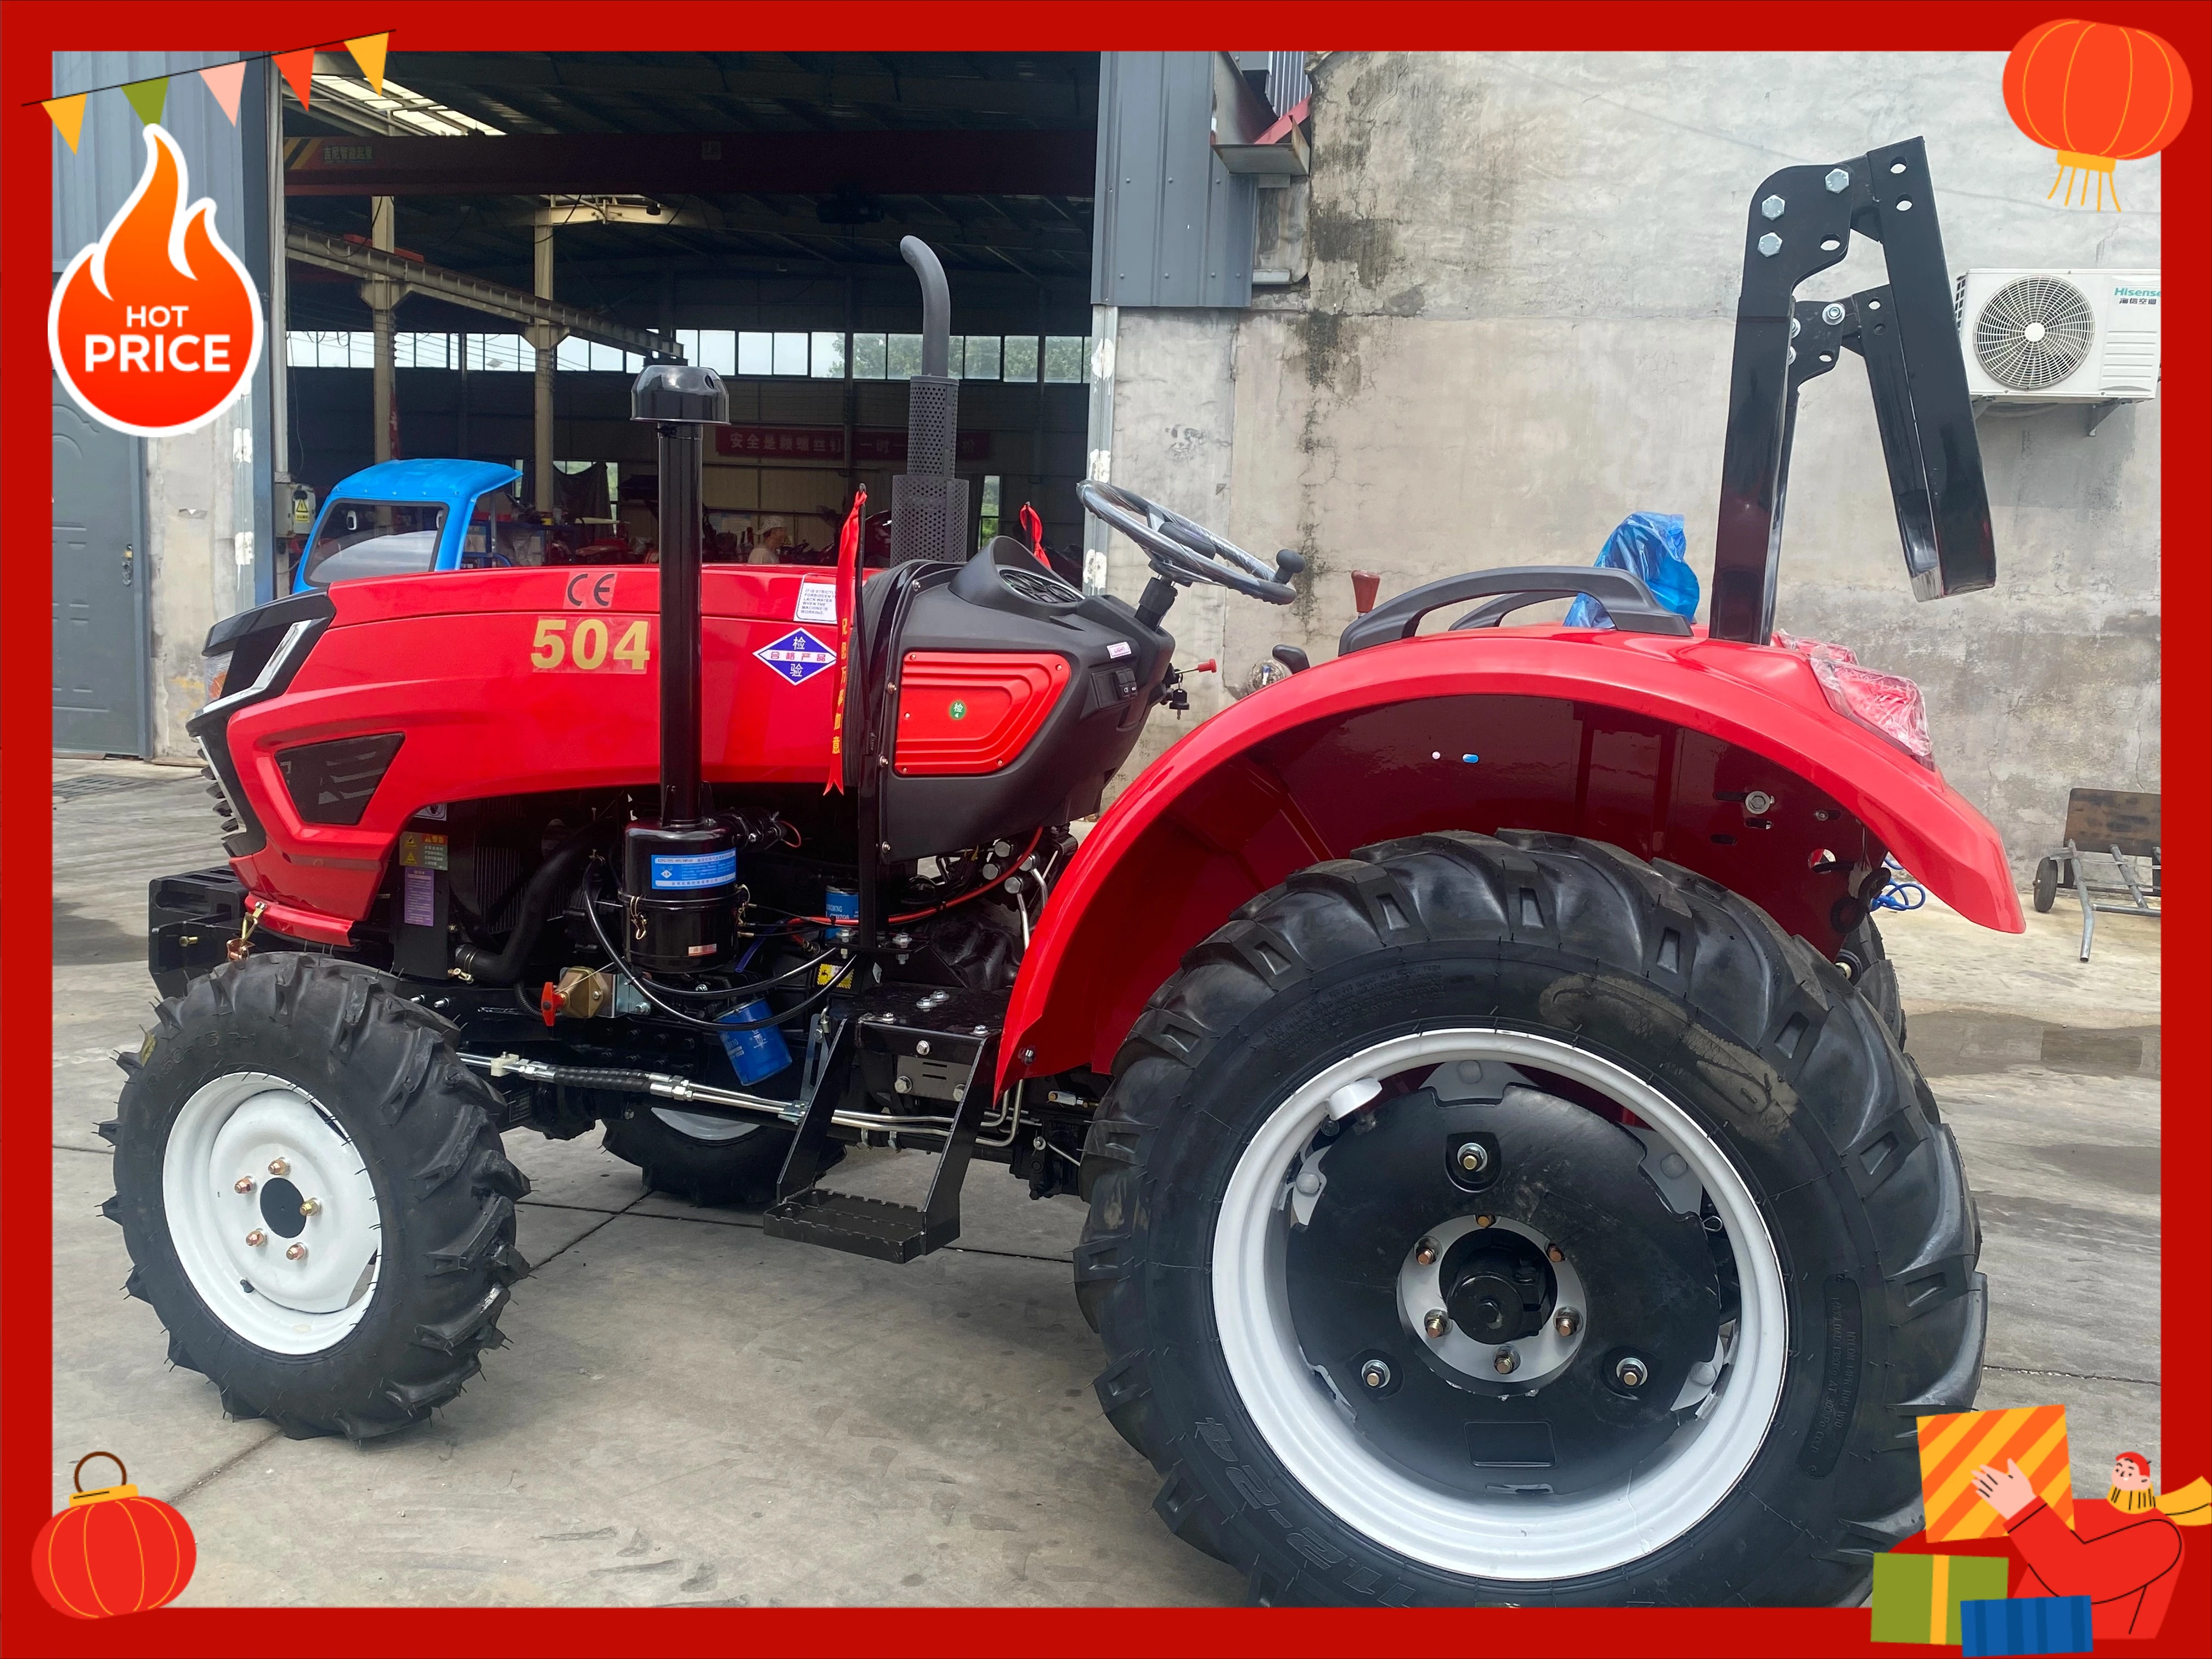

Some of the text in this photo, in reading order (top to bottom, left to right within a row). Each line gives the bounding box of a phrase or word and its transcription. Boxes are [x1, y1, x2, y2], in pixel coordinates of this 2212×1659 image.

[567, 573, 615, 606] CE
[531, 619, 651, 670] 504
[793, 636, 806, 650] 检
[790, 663, 803, 677] 验
[1846, 1331, 1857, 1360] NYLON
[1828, 1380, 1838, 1393] AT
